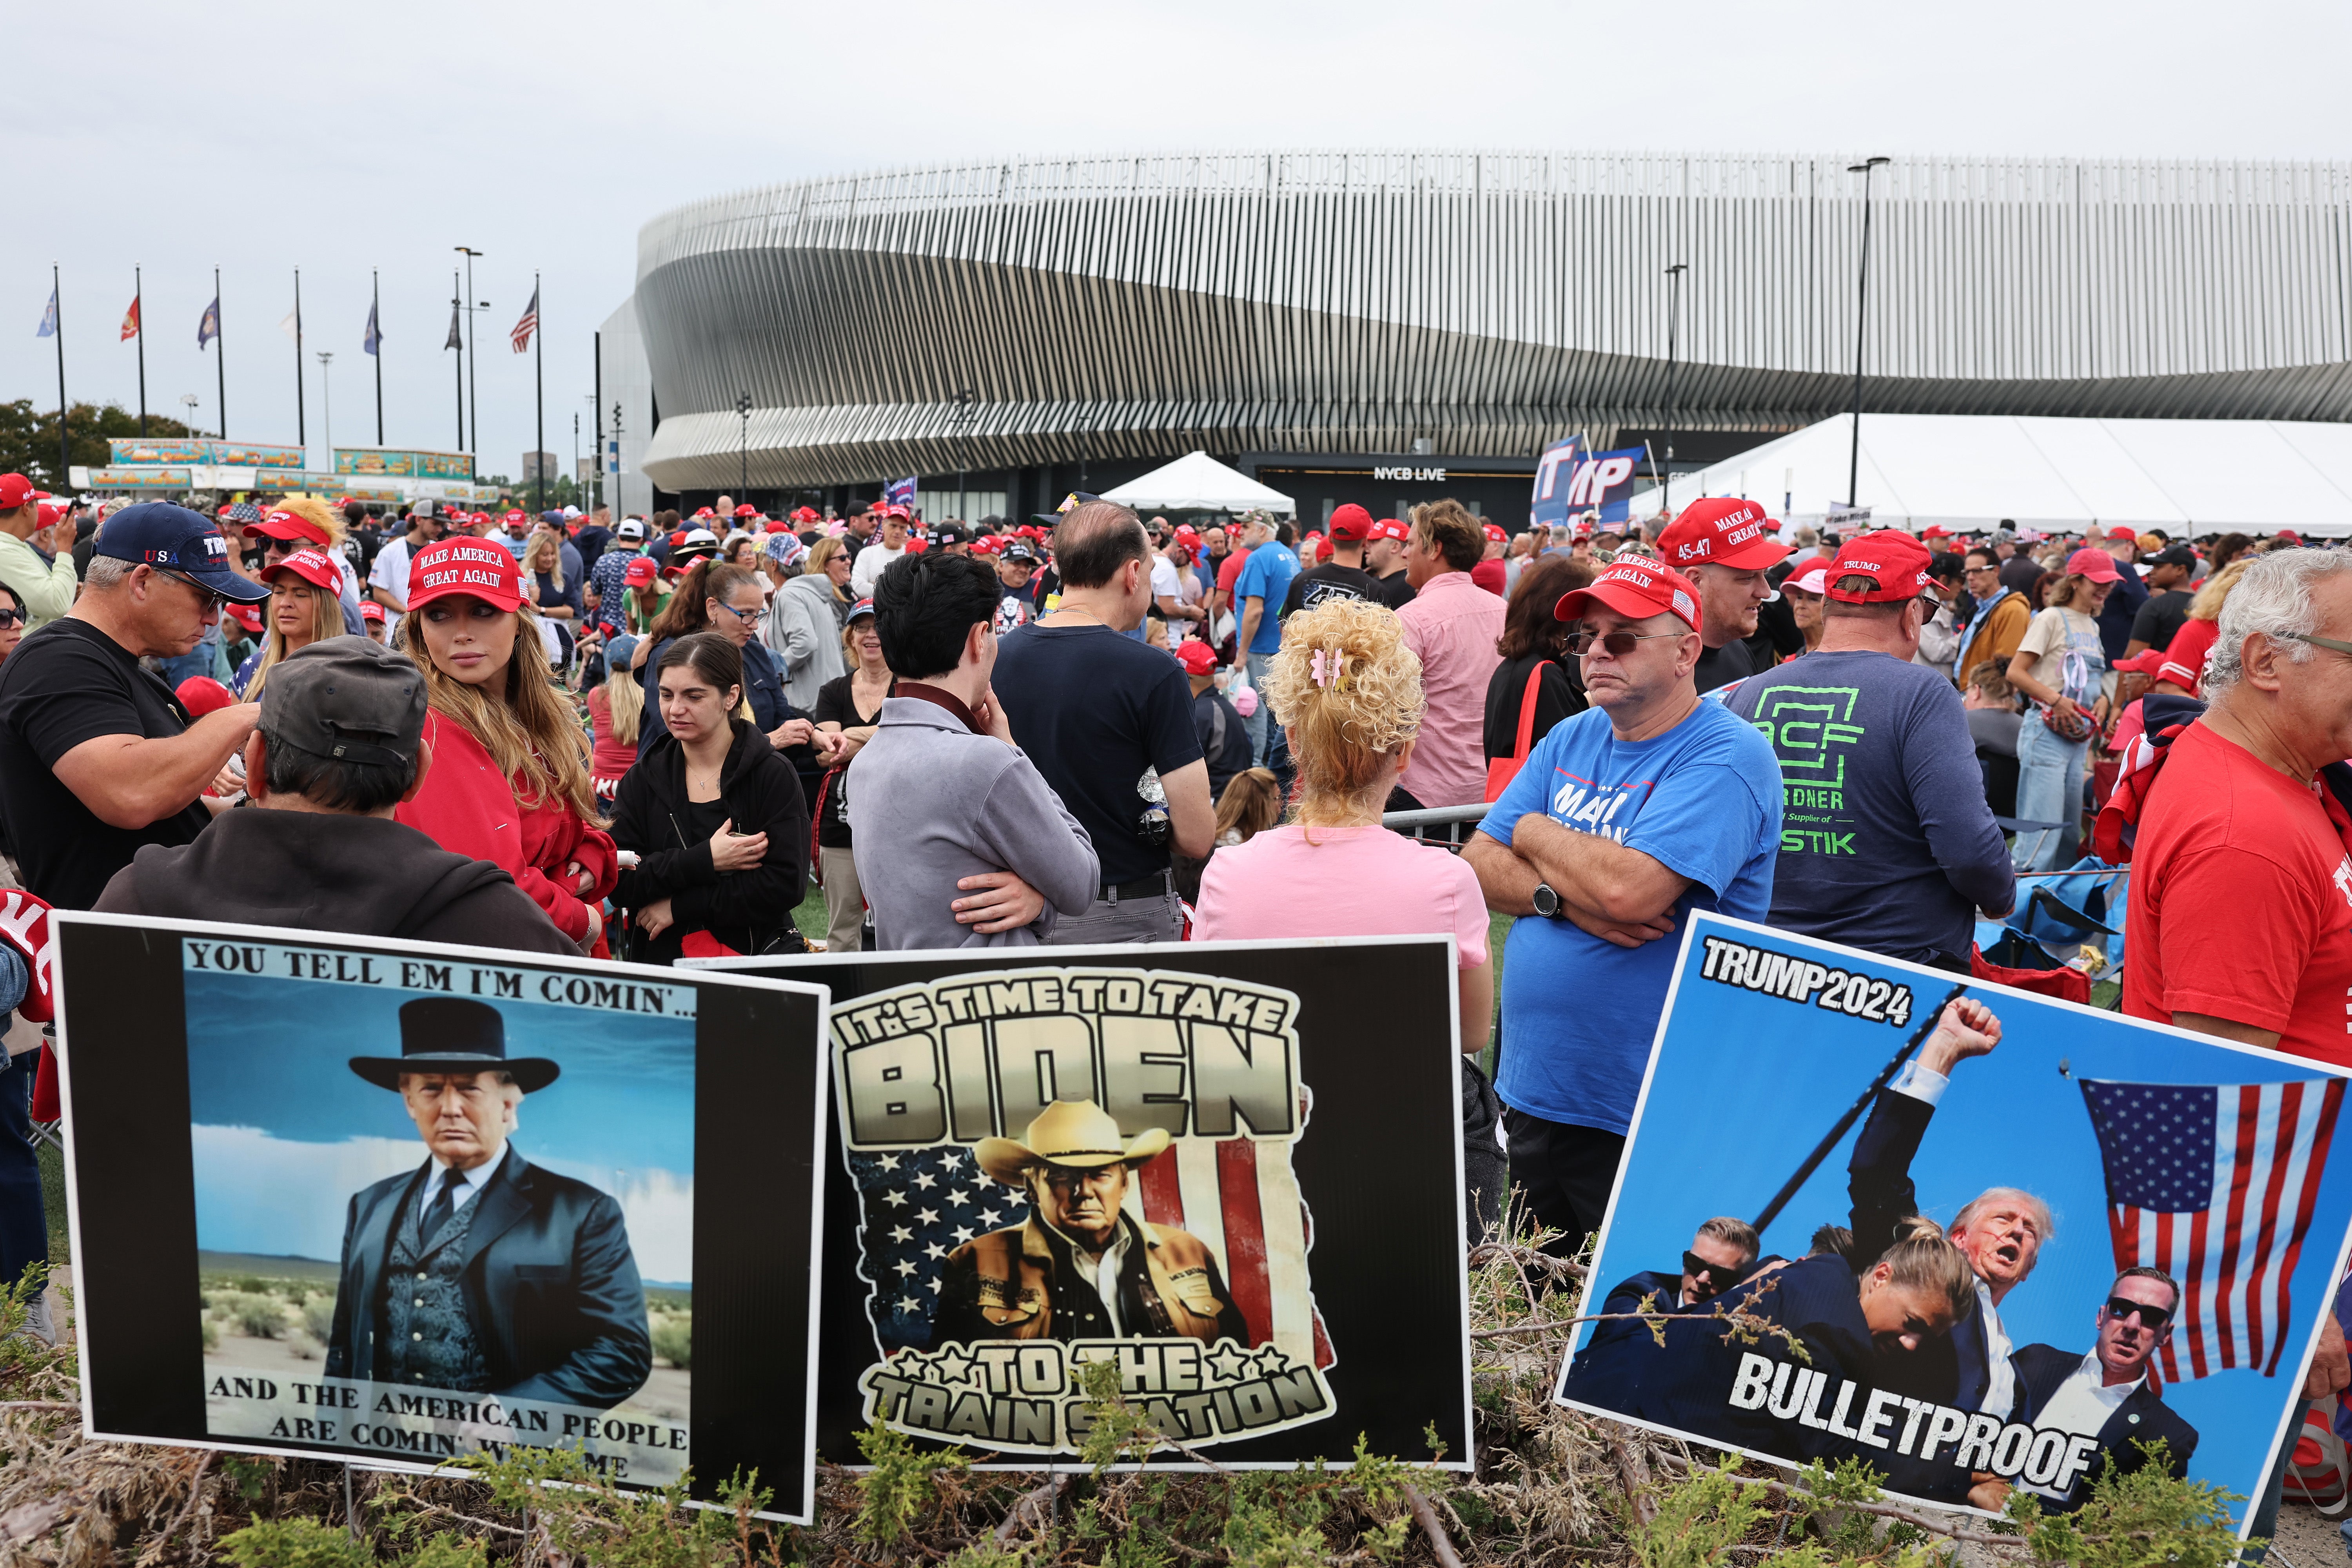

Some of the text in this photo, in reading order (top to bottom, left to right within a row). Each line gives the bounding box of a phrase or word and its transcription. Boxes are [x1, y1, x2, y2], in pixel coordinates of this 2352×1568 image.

[1374, 466, 1446, 481] NYCB LIVE
[1714, 511, 1744, 532] MAKE
[1728, 524, 1756, 545] GREAT
[144, 550, 180, 564] USA
[298, 549, 327, 566] AMERICA
[420, 547, 504, 570] MAKE AMERICA
[1678, 538, 1710, 560] 45-47
[297, 556, 320, 570] AGAIN
[1613, 553, 1664, 575] AMERICA
[1844, 561, 1881, 572] TRUMP
[423, 569, 501, 588] GREAT AGAIN
[1611, 568, 1652, 588] AGAIN
[1788, 813, 1820, 822] Supplier
[187, 943, 266, 973] YOU
[284, 951, 383, 985] TELL
[401, 962, 453, 992] EM
[470, 969, 523, 999] I'M
[836, 976, 1290, 1045] IT'S TIME TO TAKE
[843, 1014, 1295, 1145] BIDEN
[973, 1343, 1064, 1396] TO
[209, 1376, 688, 1450] AND THE AMERICAN PEOPLE
[867, 1371, 1056, 1445] TRAIN
[1728, 1351, 2099, 1490] BULLETPROOF
[269, 1416, 337, 1441] ARE
[351, 1423, 462, 1455] COMIN'
